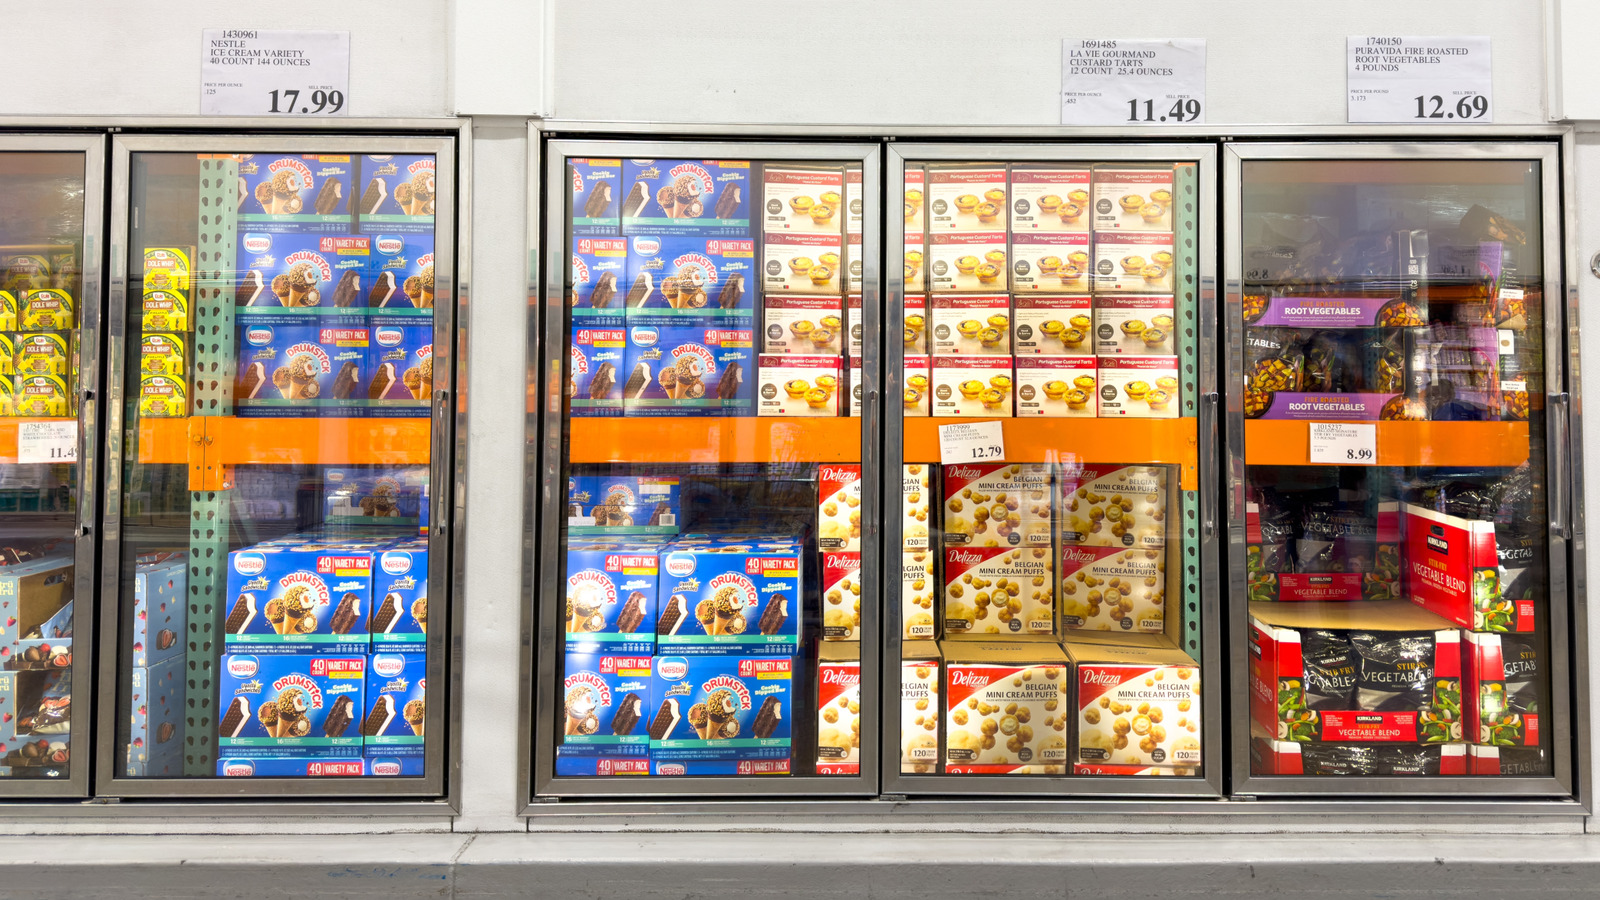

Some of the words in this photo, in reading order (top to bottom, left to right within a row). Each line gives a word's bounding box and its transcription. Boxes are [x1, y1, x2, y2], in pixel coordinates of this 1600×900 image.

[222, 30, 258, 39] 1430961
[210, 40, 246, 48] NESTLE
[1081, 40, 1117, 49] 1691485
[1365, 37, 1402, 45] 1740150
[228, 49, 261, 57] CREAM
[264, 50, 304, 58] VARIETY
[1070, 50, 1082, 58] LA
[1085, 50, 1100, 58] VIE
[1102, 50, 1156, 59] GOURMAND
[1355, 47, 1402, 55] PURAVIDA
[1404, 47, 1424, 55] FIRE
[1426, 48, 1469, 56] ROASTED
[209, 57, 220, 65] 40
[1070, 59, 1112, 67] CUSTARD
[1115, 59, 1143, 67] TARTS
[1383, 56, 1441, 64] VEGETABLES
[1080, 67, 1113, 75] COUNT
[1136, 68, 1173, 76] OUNCES
[1362, 64, 1399, 72] POUNDS
[268, 89, 344, 114] 17.99
[1414, 95, 1488, 119] 12.69
[1127, 98, 1201, 123] 11.49
[159, 260, 174, 268] WHIP
[31, 301, 44, 309] DOLE
[1284, 307, 1307, 315] ROOT
[1308, 307, 1361, 315] VEGETABLES
[321, 329, 333, 339] 40
[335, 331, 353, 340] VARIETY
[354, 331, 366, 340] PACK
[1289, 403, 1311, 411] ROOT
[1312, 403, 1365, 411] VEGETABLES
[971, 446, 1002, 458] 12.79
[1347, 448, 1372, 459] 8.99
[822, 467, 857, 483] Delizza
[948, 465, 981, 479] Delizza
[1427, 536, 1448, 549] KIRKLAND
[949, 550, 983, 564] Delizza
[1063, 548, 1096, 562] Delizza
[318, 557, 331, 568] 40
[334, 558, 355, 569] VARIETY
[356, 558, 369, 568] PACK
[747, 558, 760, 569] 40
[762, 559, 782, 569] VARIETY
[783, 560, 796, 569] PACK
[1412, 561, 1445, 585] VEGETABLE
[1445, 575, 1466, 593] BLEND
[280, 573, 329, 605] DRUMSTICK
[711, 574, 758, 606] DRUMSTICK
[312, 659, 325, 671] 40
[327, 661, 348, 671] VARIETY
[349, 661, 362, 670] PACK
[1320, 656, 1347, 665] KIRKLAND
[1340, 666, 1355, 675] FRY
[823, 669, 860, 685] Delizza
[952, 670, 990, 686] Delizza
[1083, 669, 1122, 686] Delizza
[1363, 671, 1424, 683] VEGETABLE
[274, 676, 322, 709] DRUMSTICK
[1025, 683, 1058, 691] BELGIAN
[1157, 683, 1190, 691] BELGIAN
[1259, 683, 1273, 702] BLEND
[1117, 690, 1136, 698] MINI
[1167, 691, 1191, 699] PUFFS
[1176, 751, 1189, 759] 120
